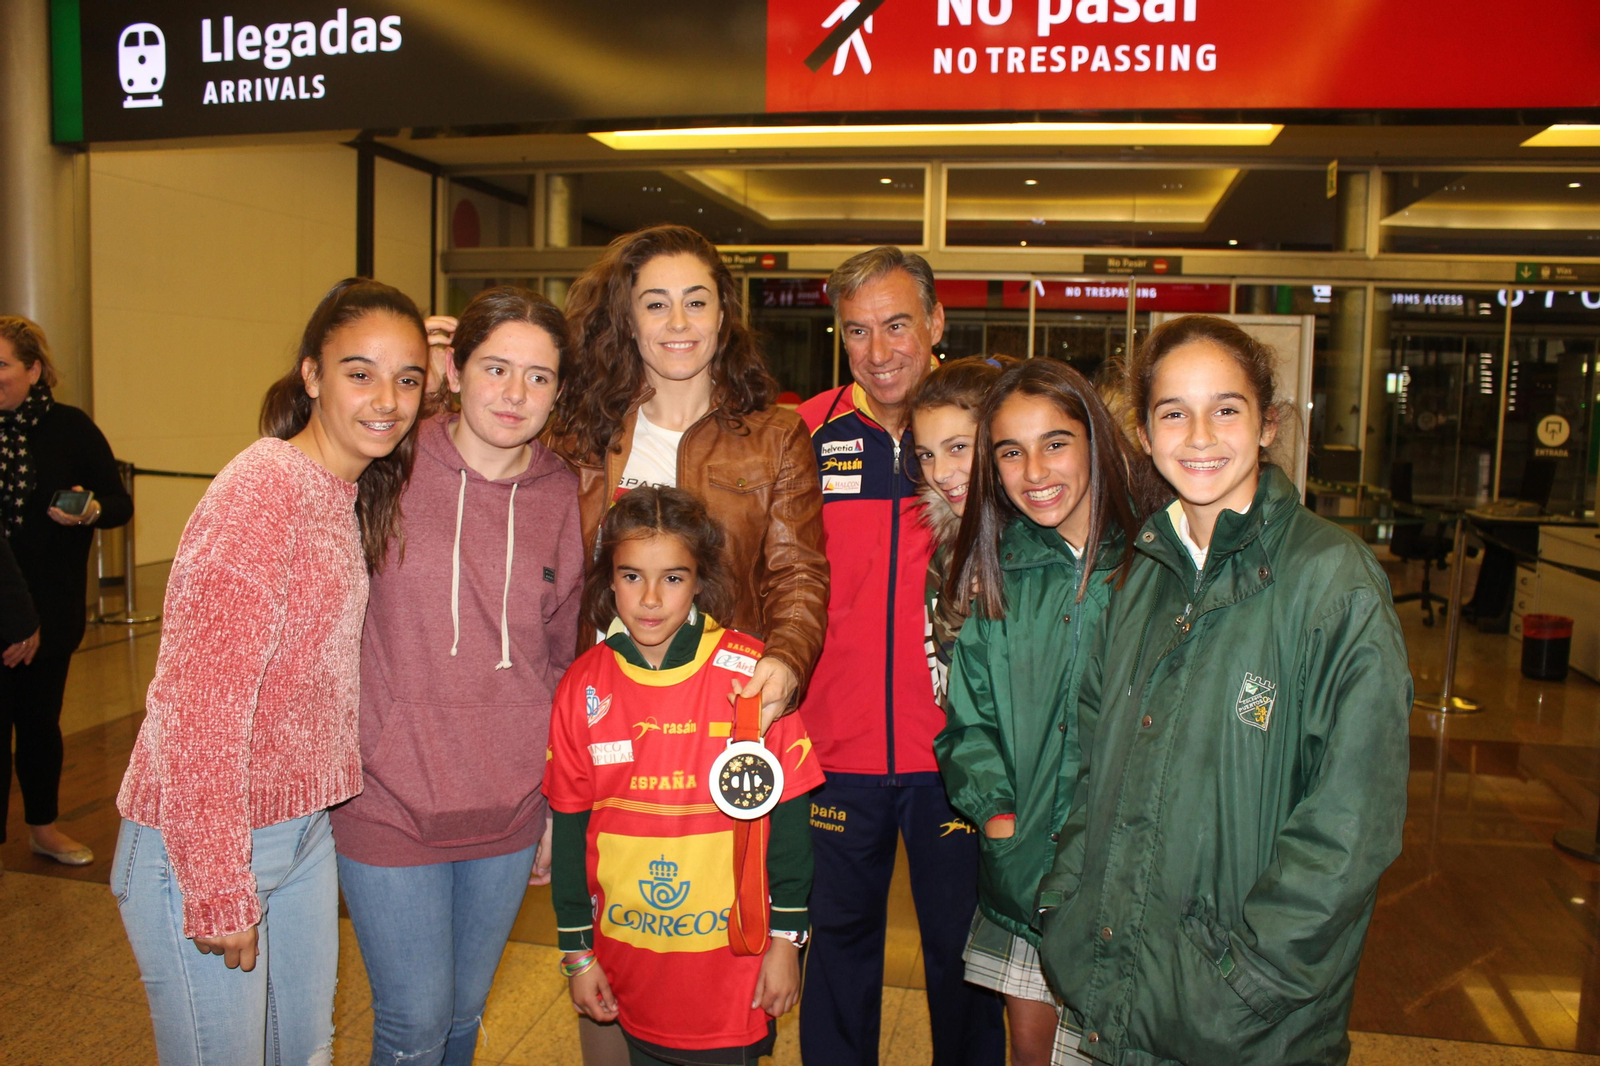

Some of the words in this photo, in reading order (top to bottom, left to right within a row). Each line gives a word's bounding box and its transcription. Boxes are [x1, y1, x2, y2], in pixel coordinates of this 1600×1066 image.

[201, 8, 402, 70] Llegadas
[933, 47, 977, 74] NO
[985, 44, 1217, 73] TRESPASSING
[203, 74, 326, 105] ARRIVALS
[1108, 258, 1121, 267] No
[1123, 258, 1147, 268] Pasar
[1065, 286, 1081, 297] NO
[1423, 294, 1463, 306] ACCESS
[822, 444, 853, 454] helvetia
[1535, 448, 1569, 458] ENTRADA
[838, 458, 862, 471] rasán
[663, 719, 697, 734] rasán
[629, 770, 697, 790] ESPAÑA
[608, 903, 731, 937] CORREOS
